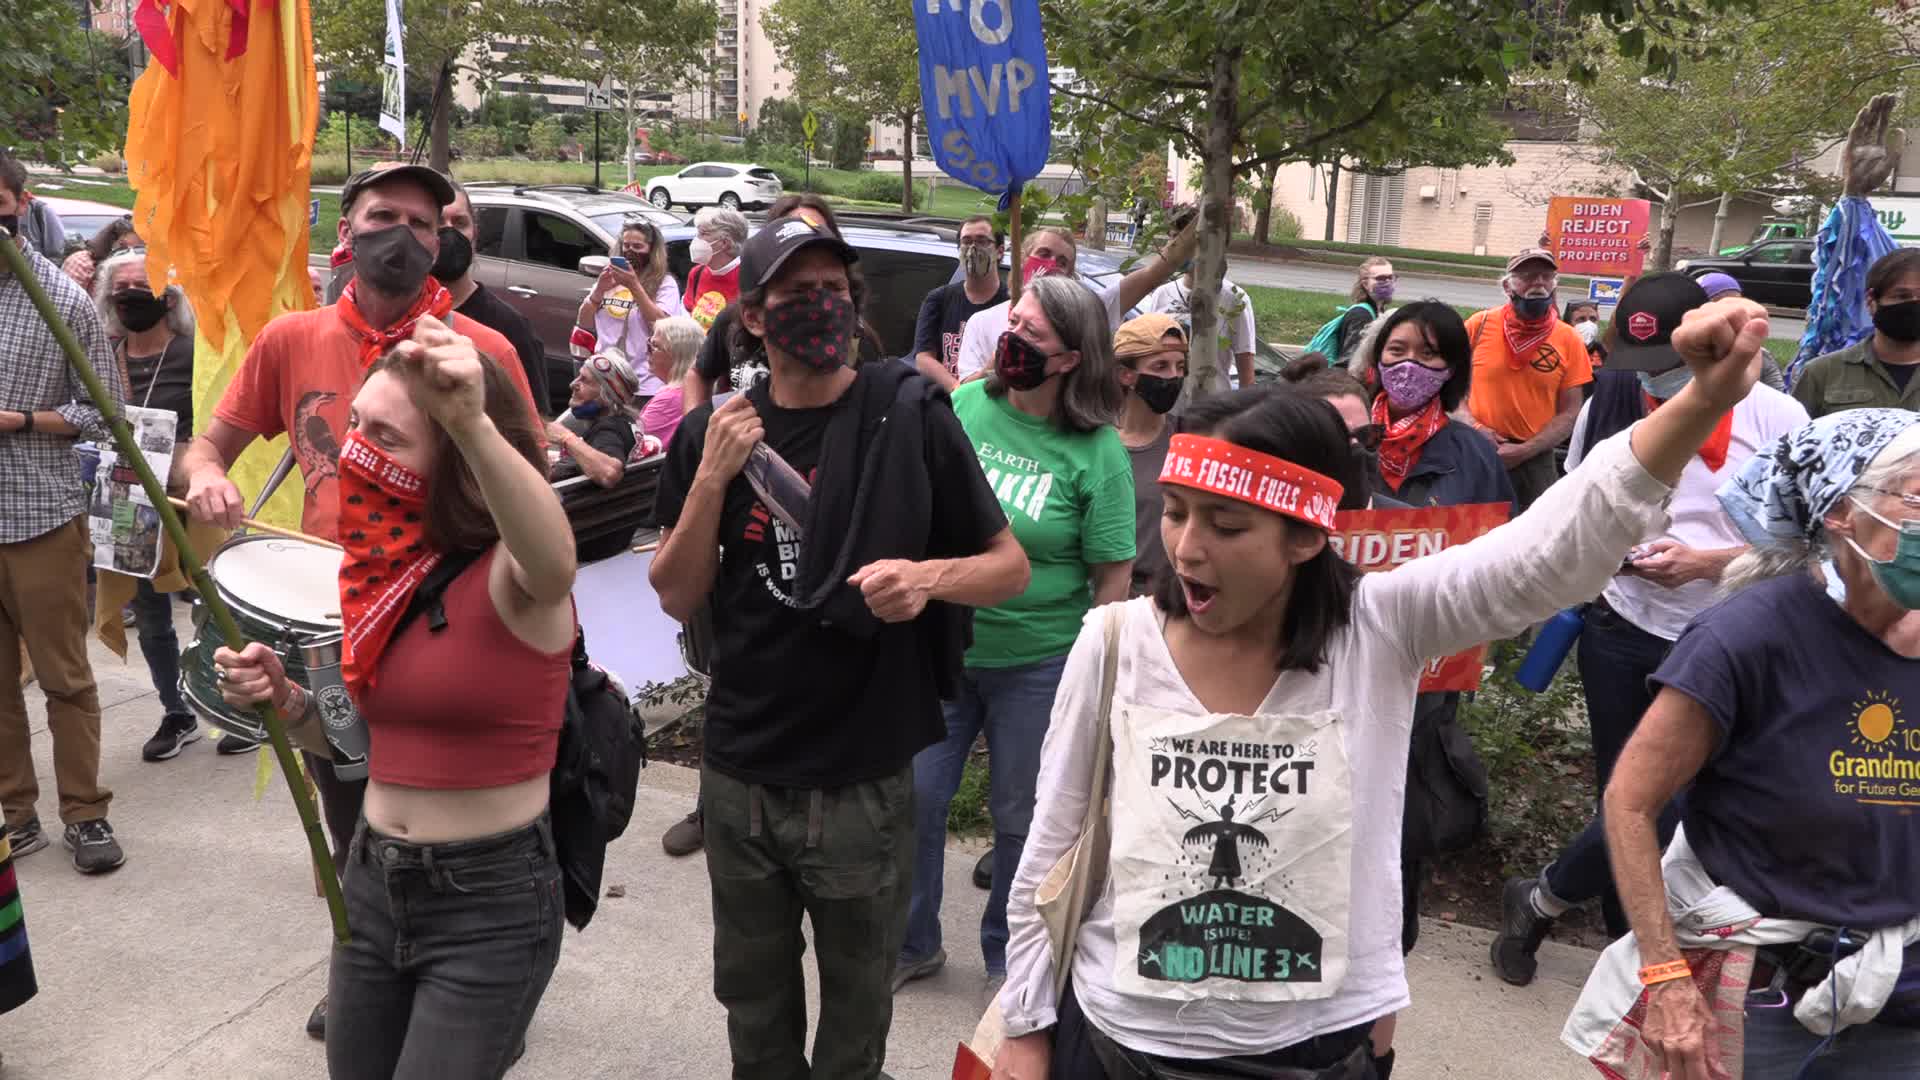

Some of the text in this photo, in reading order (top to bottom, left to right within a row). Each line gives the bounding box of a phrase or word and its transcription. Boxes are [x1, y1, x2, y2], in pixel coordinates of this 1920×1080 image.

[926, 0, 1013, 45] O
[934, 57, 1035, 119] MVP
[1573, 204, 1622, 217] BIDEN
[1561, 219, 1631, 235] REJECT
[1560, 237, 1630, 248] FOSSIL FUEL
[1558, 250, 1629, 262] PROJECTS
[977, 442, 1040, 473] EARTH
[1196, 457, 1253, 498] FOSSIL
[1255, 474, 1301, 513] FUELS
[1172, 738, 1294, 759] WE ARE HERE TO
[1151, 754, 1315, 794] PROTECT
[1834, 779, 1856, 794] for
[1858, 780, 1897, 796] Future
[1180, 902, 1275, 927] WATER
[1164, 942, 1292, 980] NO LINE 3
